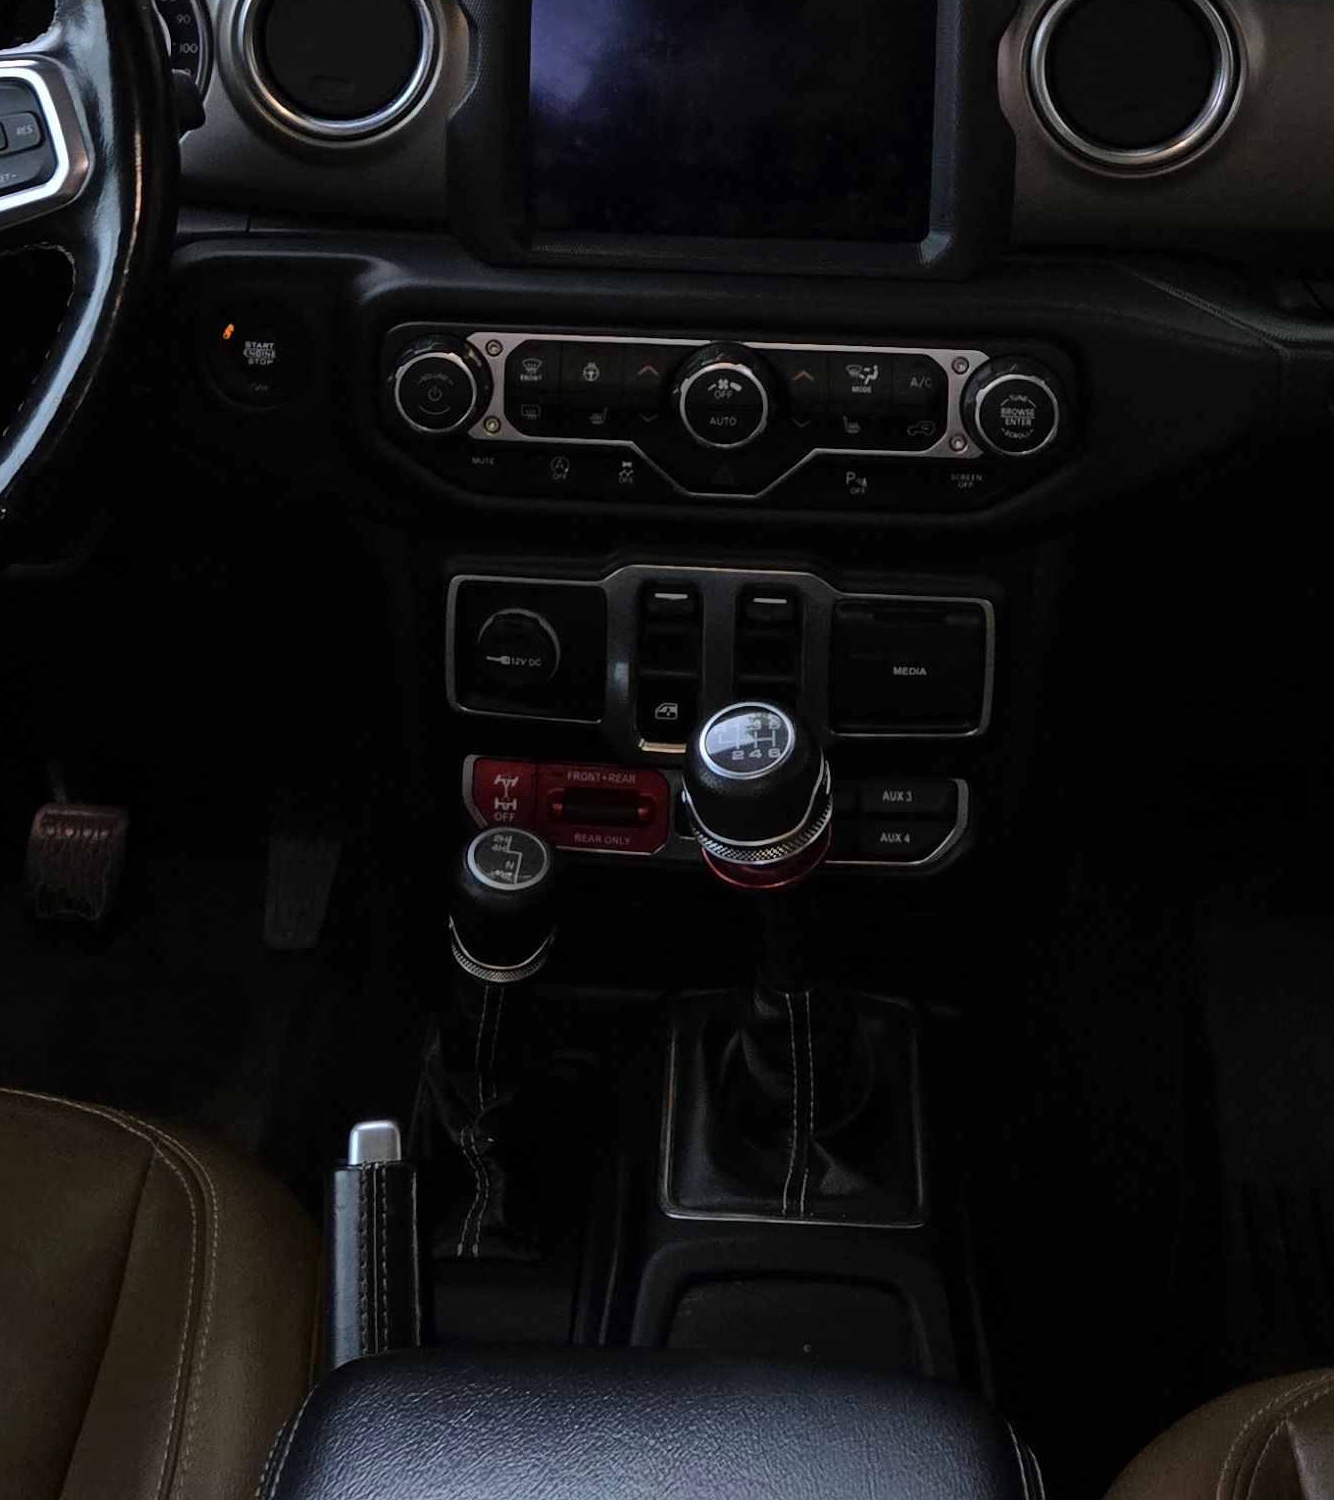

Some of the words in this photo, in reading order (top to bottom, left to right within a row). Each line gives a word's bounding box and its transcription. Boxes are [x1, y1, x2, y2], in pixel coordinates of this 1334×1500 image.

[176, 14, 191, 25] 90
[179, 43, 198, 54] 100
[17, 125, 34, 137] RES
[244, 340, 274, 349] START
[520, 373, 543, 382] FRONT
[909, 376, 934, 388] A/C
[851, 385, 872, 394] MODE
[713, 390, 734, 400] OFF
[1000, 407, 1035, 417] BROWSE
[709, 417, 737, 427] AUTO
[1004, 418, 1032, 426] ENTER
[471, 456, 496, 465] MUTE
[950, 472, 983, 481] SCREEN
[511, 658, 527, 666] 12V
[528, 658, 542, 667] DC
[892, 666, 927, 677] MEDIA
[732, 750, 745, 761] 2
[749, 748, 763, 759] 4
[768, 747, 782, 758] 6
[882, 790, 904, 802] AUX
[905, 791, 913, 802] 3
[494, 812, 516, 822] OFF
[574, 833, 601, 843] REAR
[604, 835, 632, 845] ONLY
[880, 832, 902, 843] AUX
[903, 833, 911, 843] 4
[505, 860, 515, 870] N
